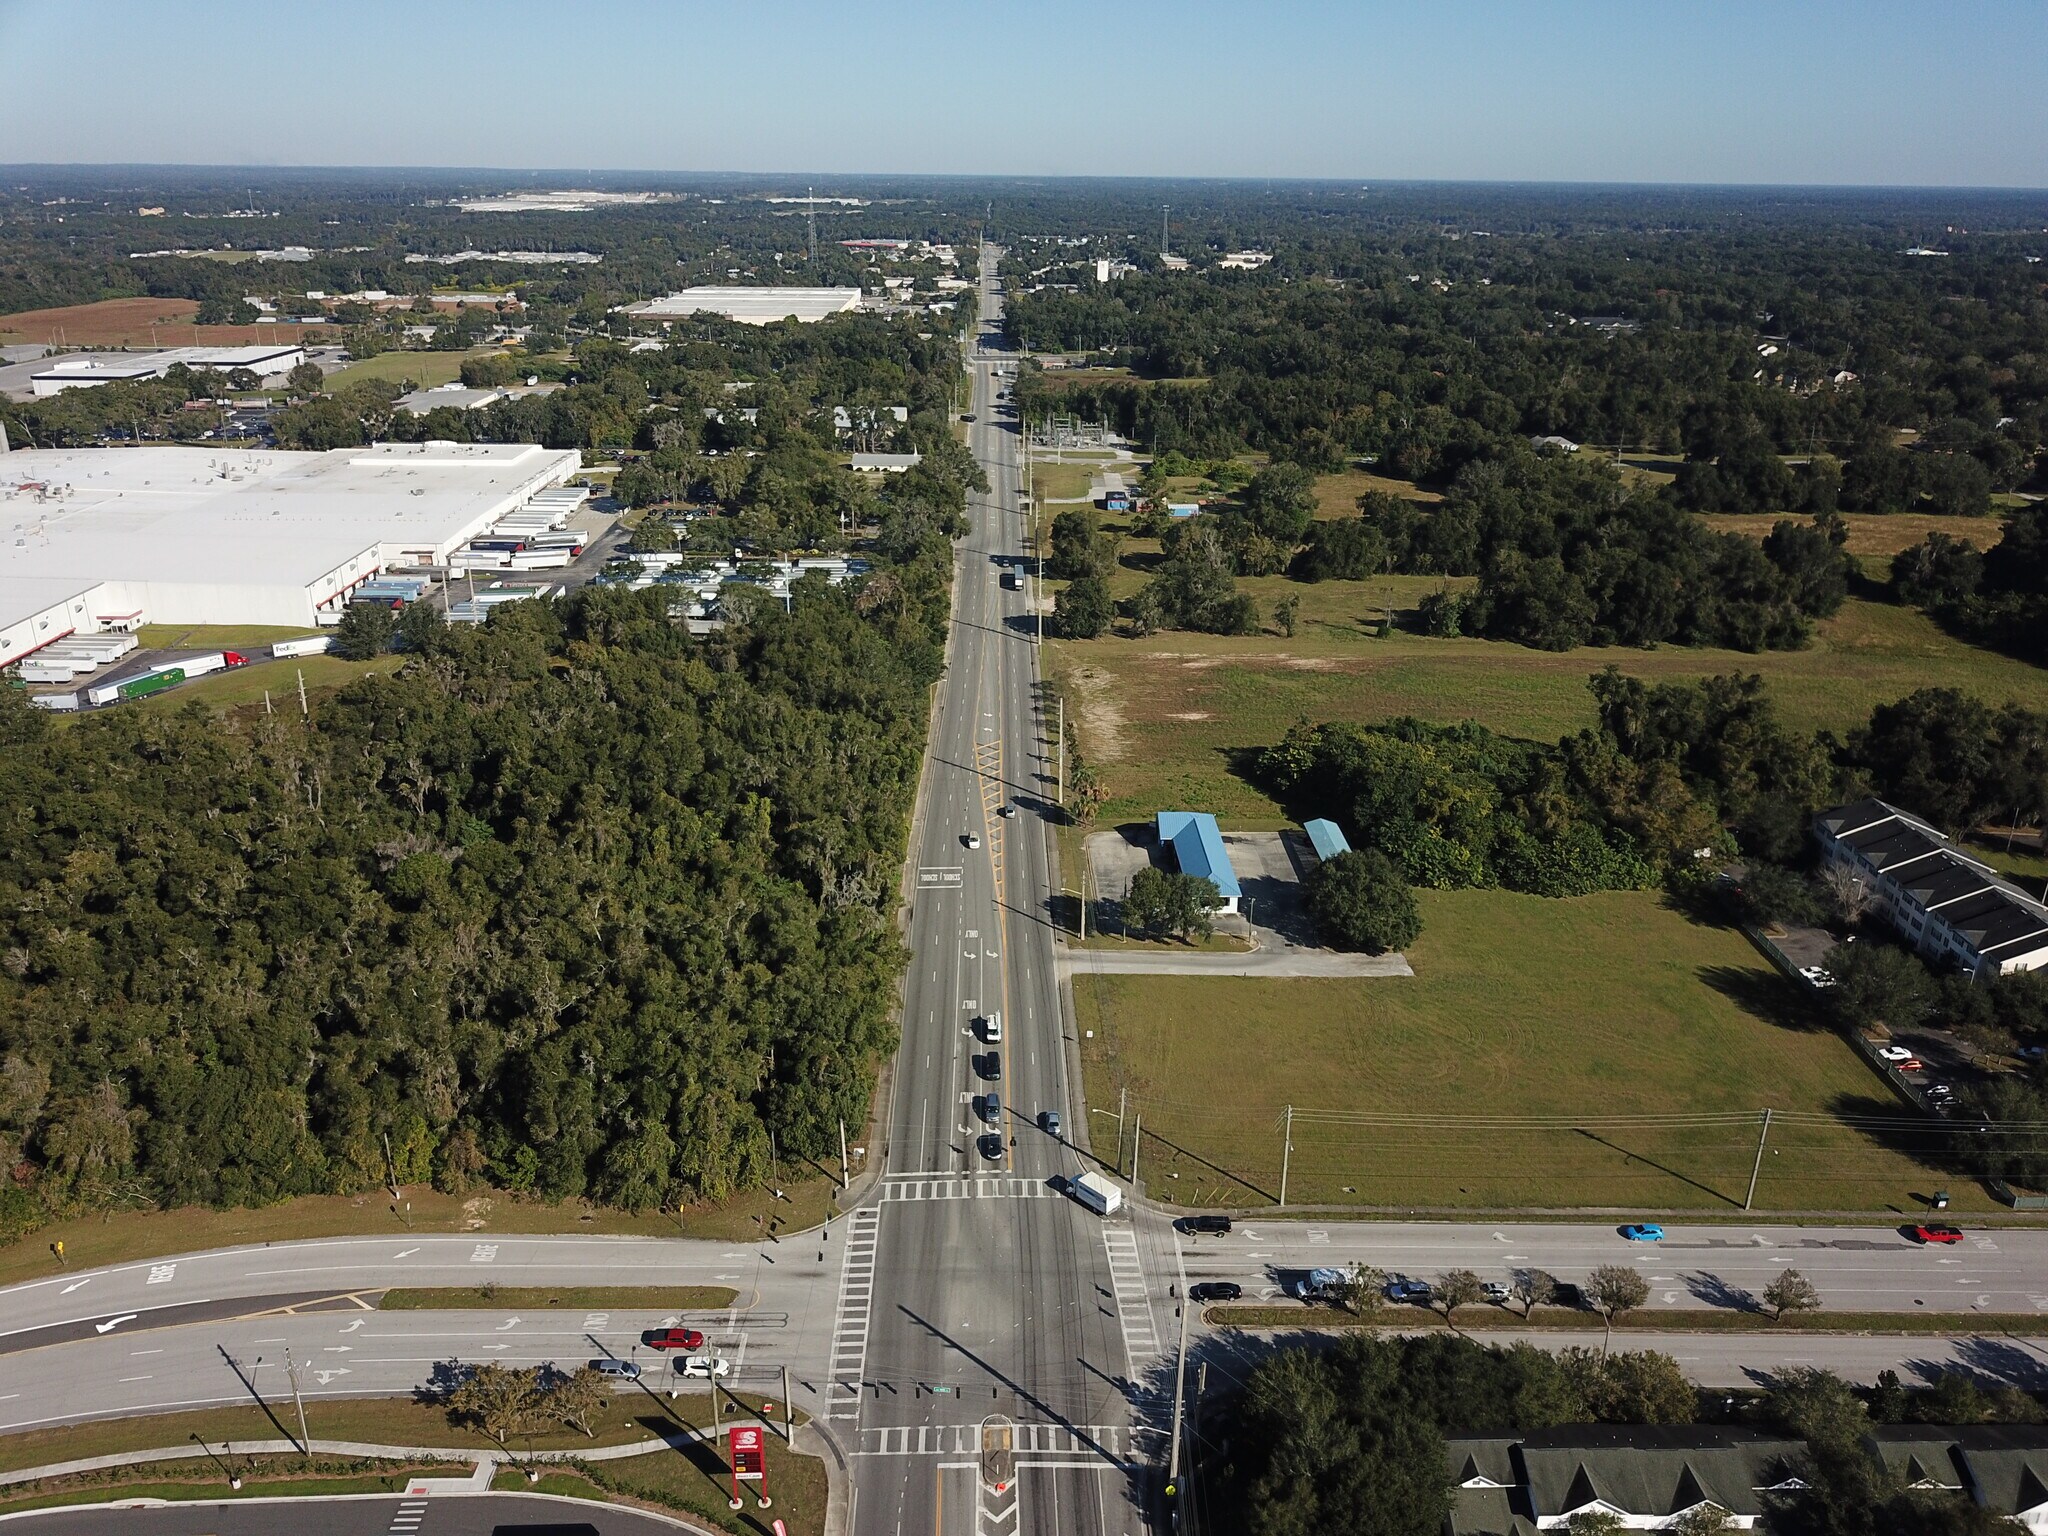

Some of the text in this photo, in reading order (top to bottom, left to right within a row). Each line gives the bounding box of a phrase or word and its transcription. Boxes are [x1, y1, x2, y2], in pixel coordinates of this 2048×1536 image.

[276, 644, 296, 652] FedEx
[965, 929, 979, 938] ONLY
[961, 1000, 977, 1010] ONLY
[1306, 1229, 1330, 1243] ONLY
[468, 1243, 499, 1262] MERGE
[145, 1261, 177, 1285] MERGE
[582, 1312, 610, 1332] ONLY
